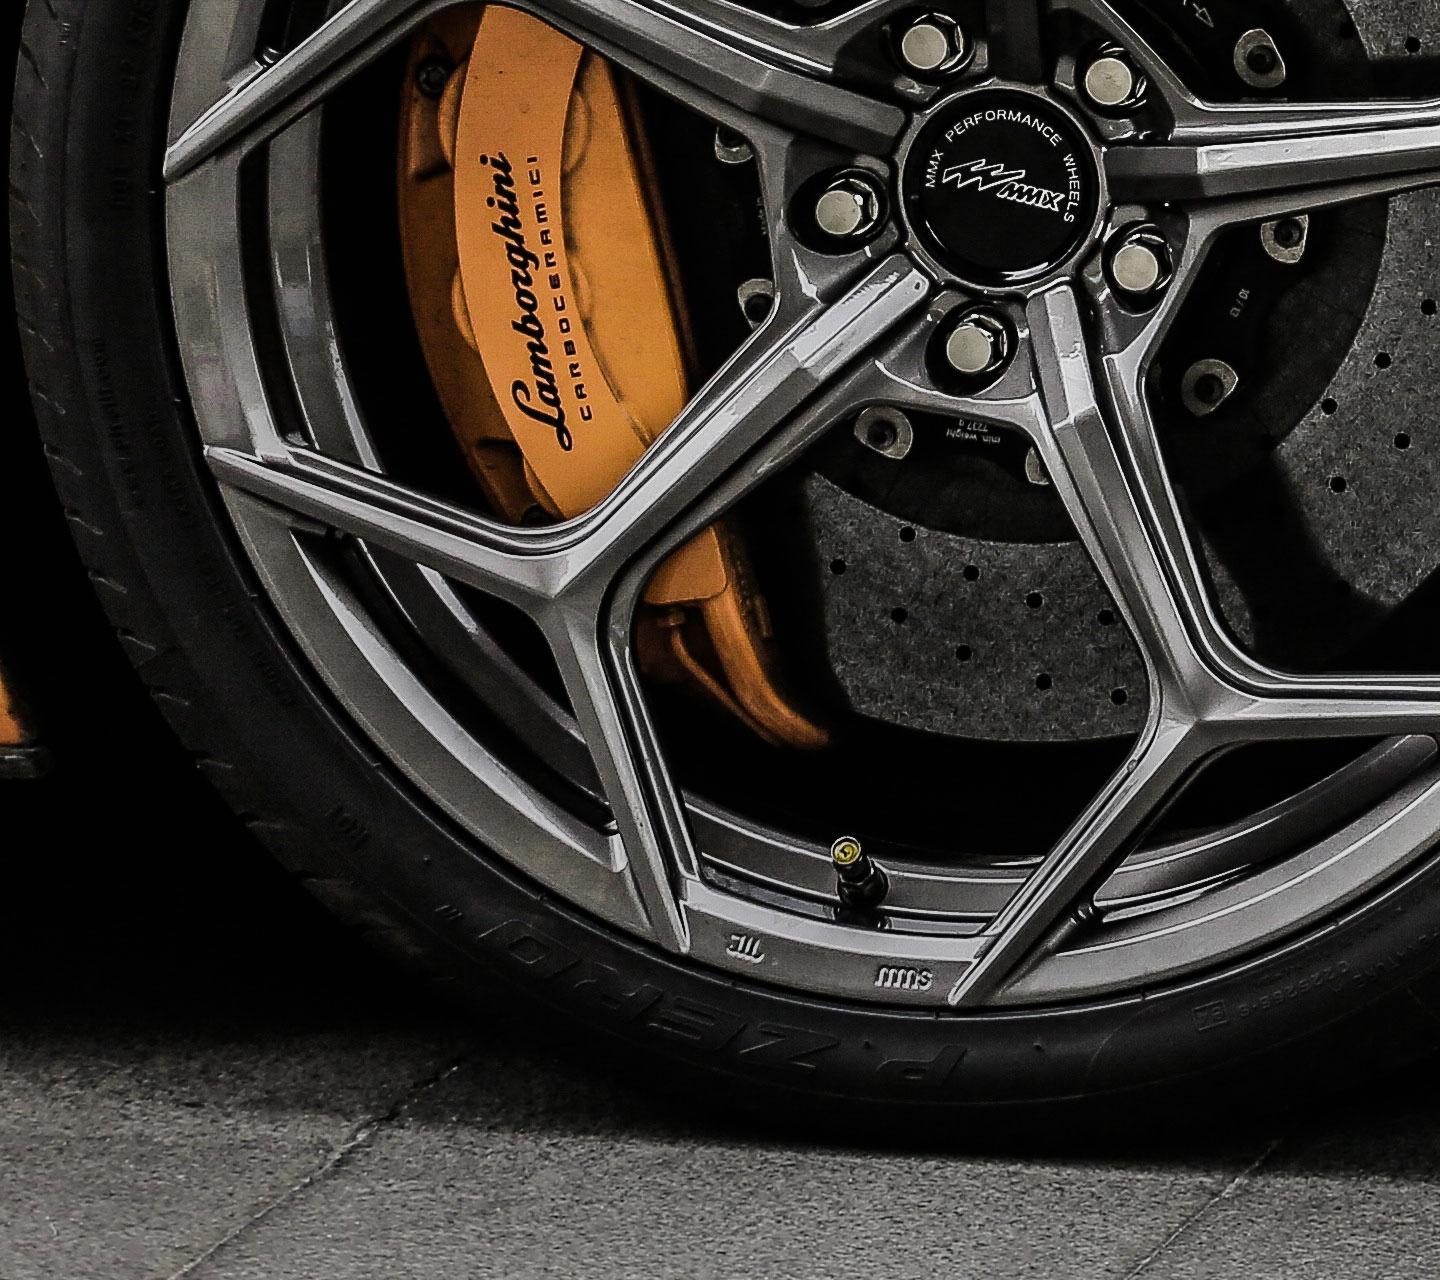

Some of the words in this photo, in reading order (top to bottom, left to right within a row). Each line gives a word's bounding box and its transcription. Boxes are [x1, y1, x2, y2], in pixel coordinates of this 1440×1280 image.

[925, 148, 944, 188] MMX
[944, 109, 1063, 147] PERFORMANCE
[1062, 152, 1081, 223] WHEELS
[479, 151, 573, 452] Lamborghini
[526, 155, 594, 422] CARBOCERAMICI
[477, 915, 839, 1074] ZERO
